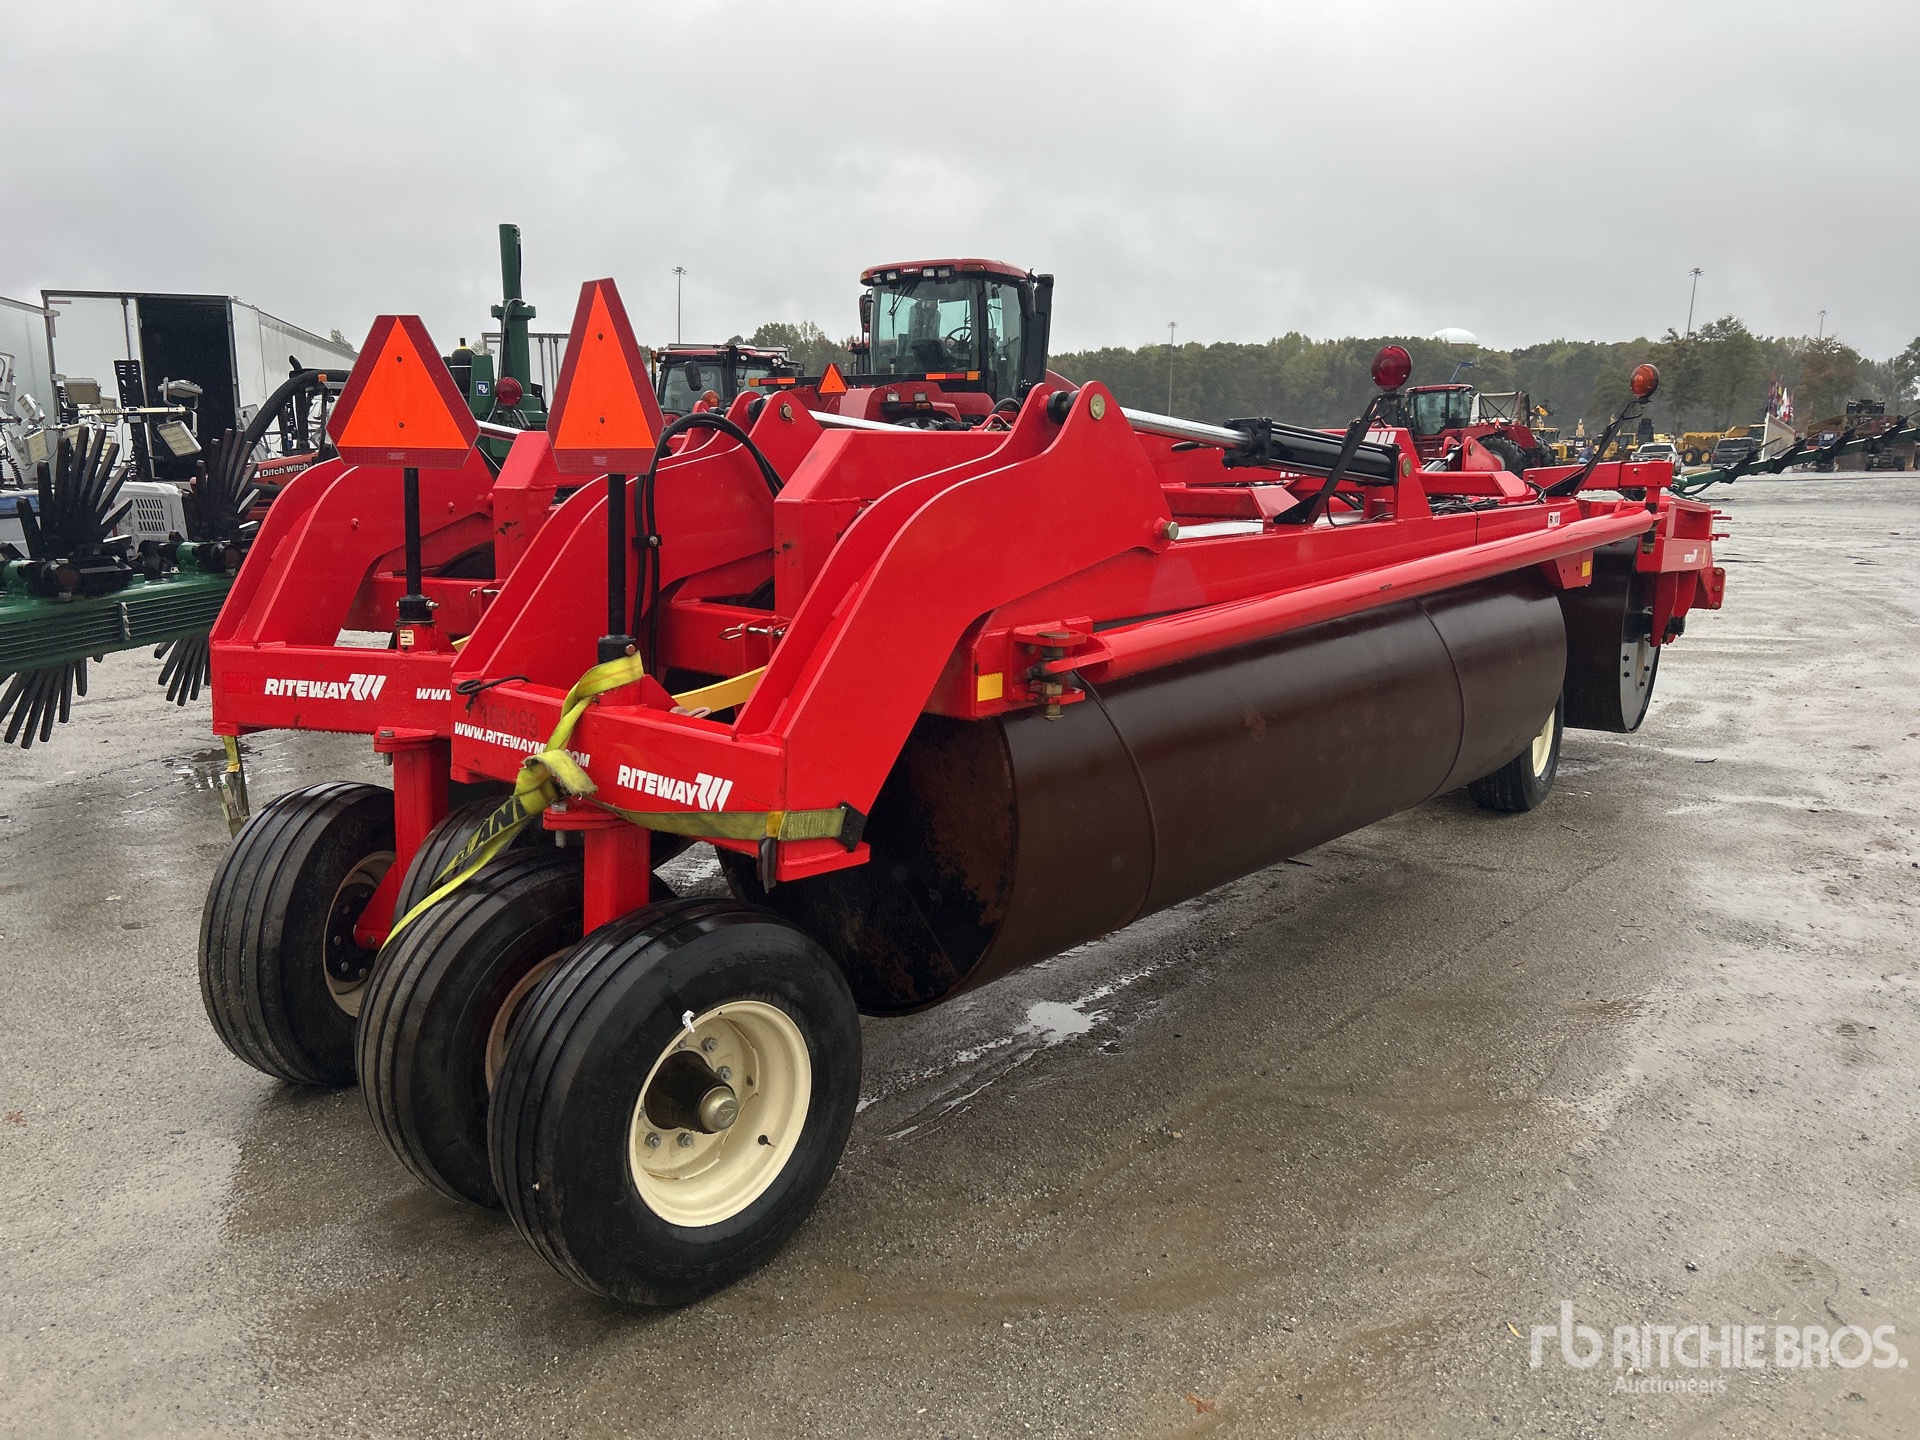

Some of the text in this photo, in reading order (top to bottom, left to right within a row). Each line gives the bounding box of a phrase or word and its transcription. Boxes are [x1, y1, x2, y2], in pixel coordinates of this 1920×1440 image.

[262, 463, 309, 477] Ditch Witch
[264, 678, 352, 700] RITEWAY
[617, 764, 699, 806] RITEWAY
